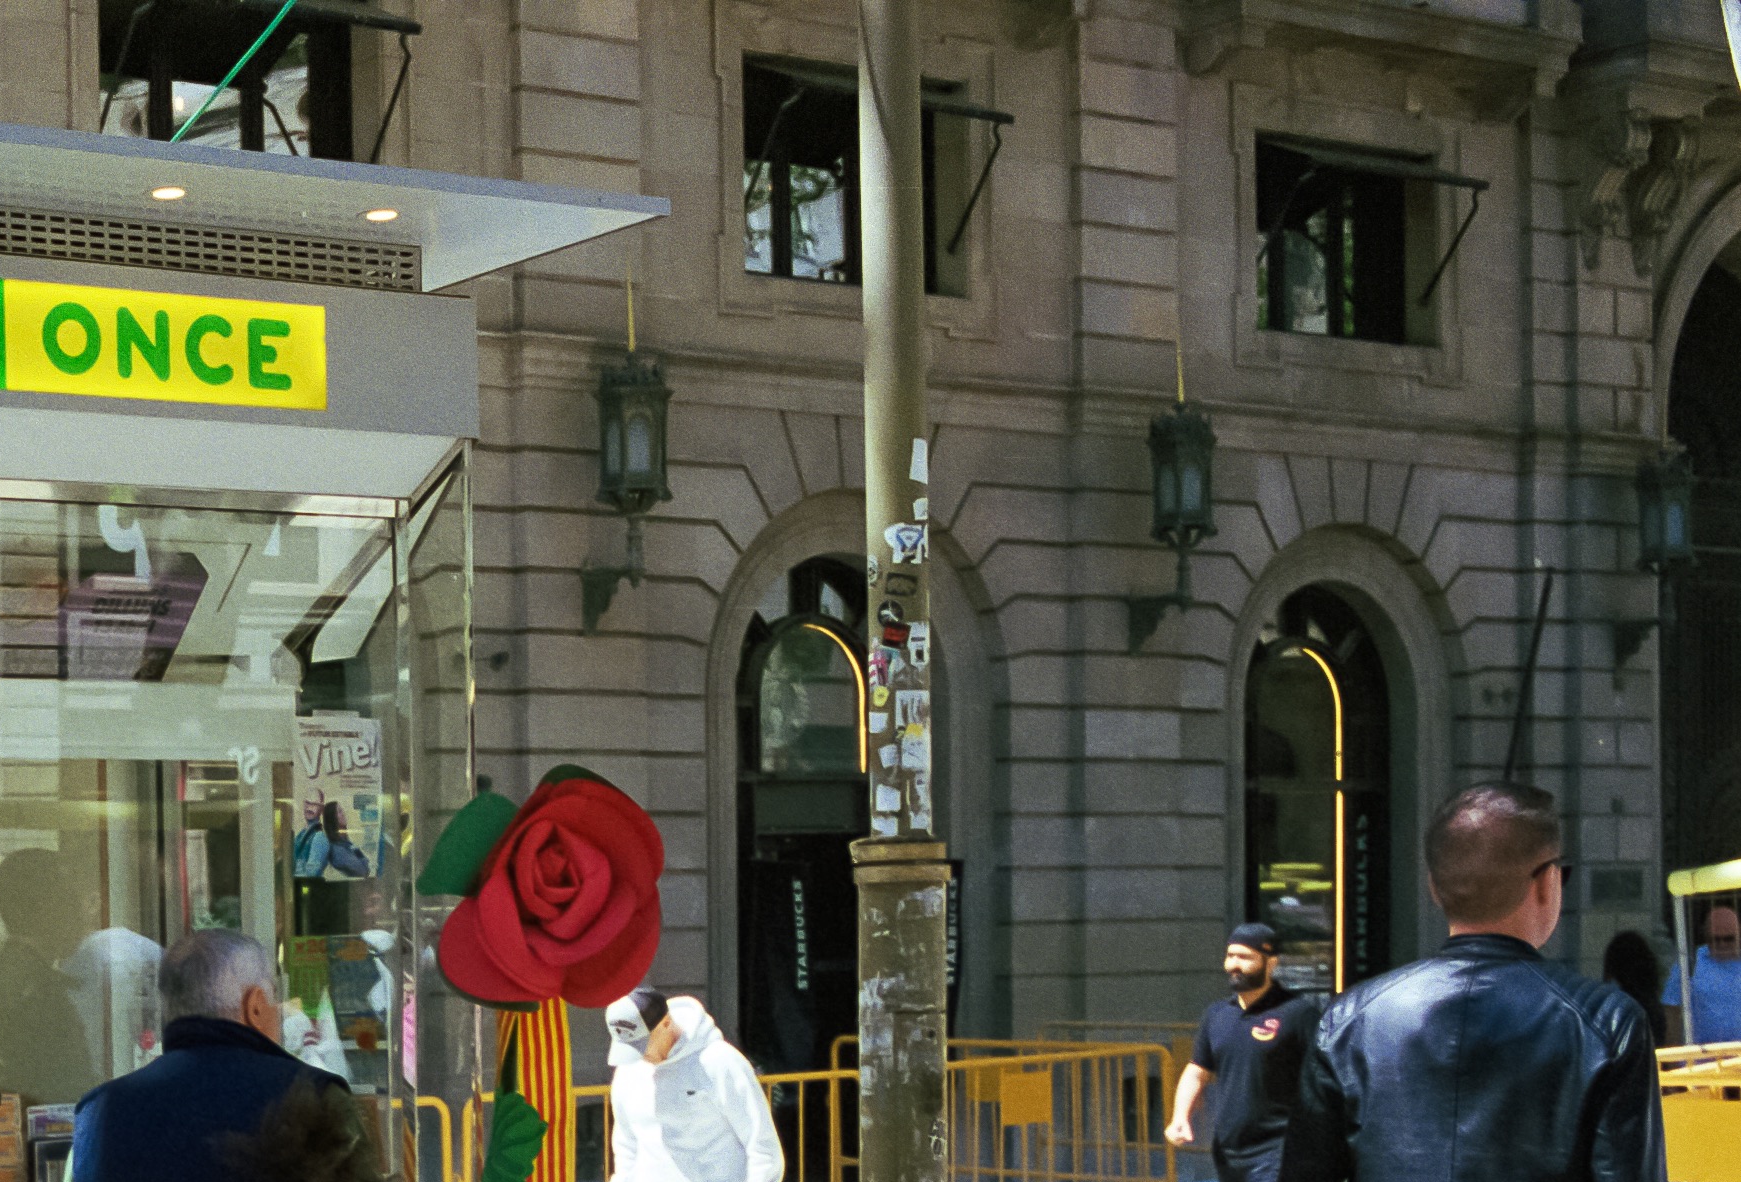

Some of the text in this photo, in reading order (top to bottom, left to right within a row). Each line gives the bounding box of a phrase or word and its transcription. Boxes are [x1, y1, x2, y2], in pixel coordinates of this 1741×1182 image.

[42, 301, 292, 391] ONCE
[298, 734, 381, 779] Vine!
[792, 879, 809, 990] STARBUCKS
